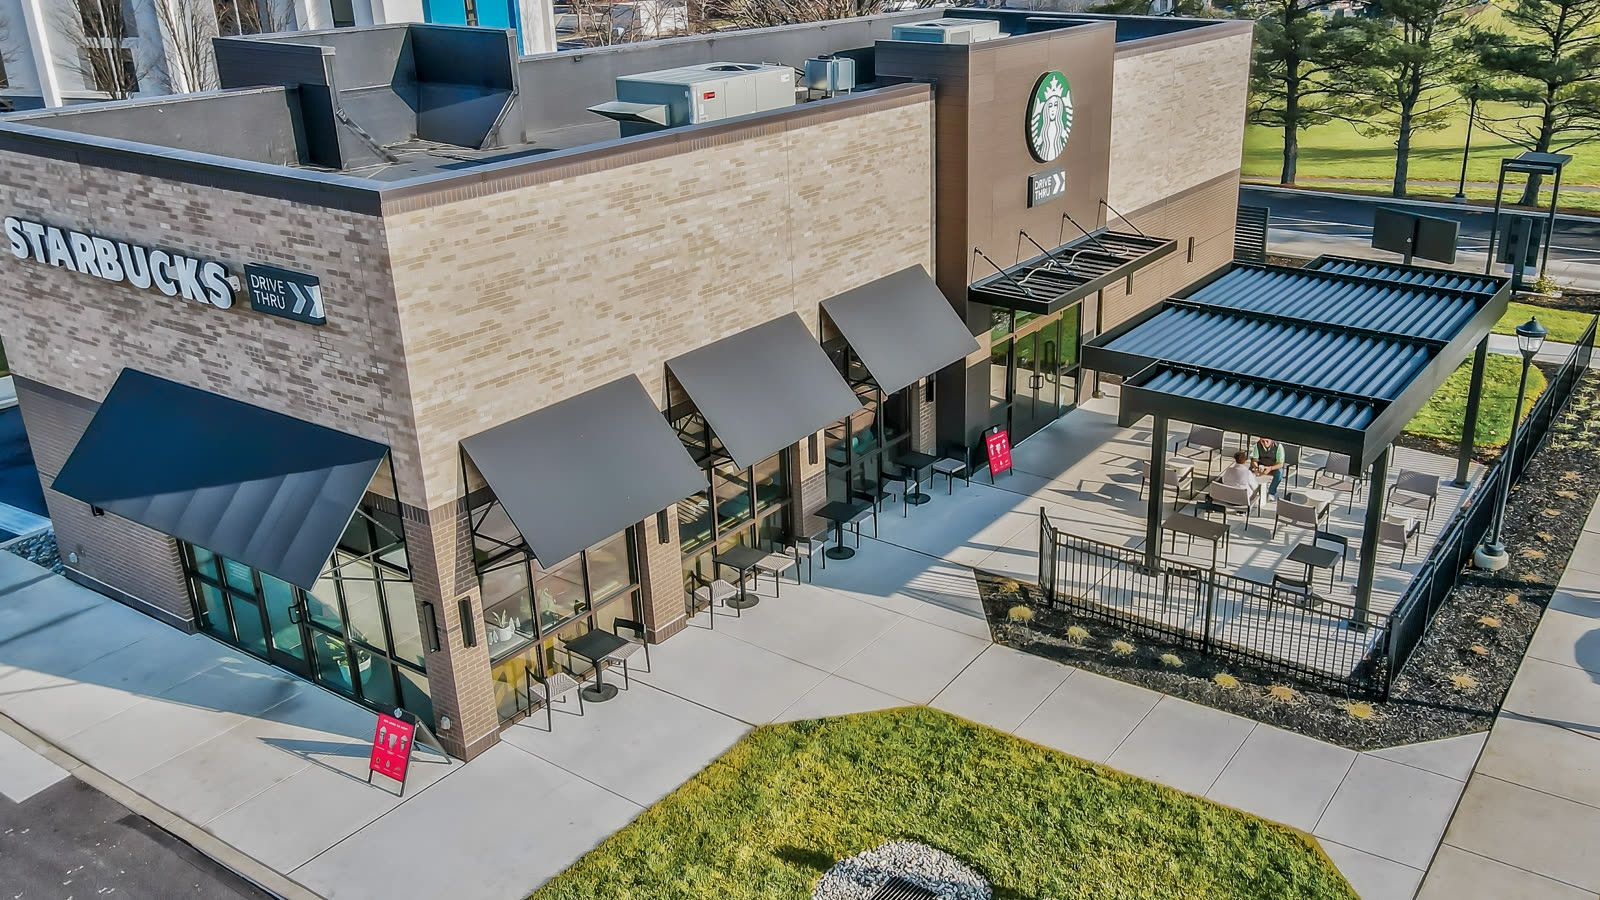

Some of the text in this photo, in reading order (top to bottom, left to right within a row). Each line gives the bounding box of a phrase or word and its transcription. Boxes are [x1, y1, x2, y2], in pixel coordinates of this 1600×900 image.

[1034, 176, 1052, 191] DRIVE
[1034, 187, 1051, 201] THRU
[4, 217, 233, 310] STARBUCKS
[250, 274, 286, 295] DRIVE
[253, 289, 286, 310] THRU
